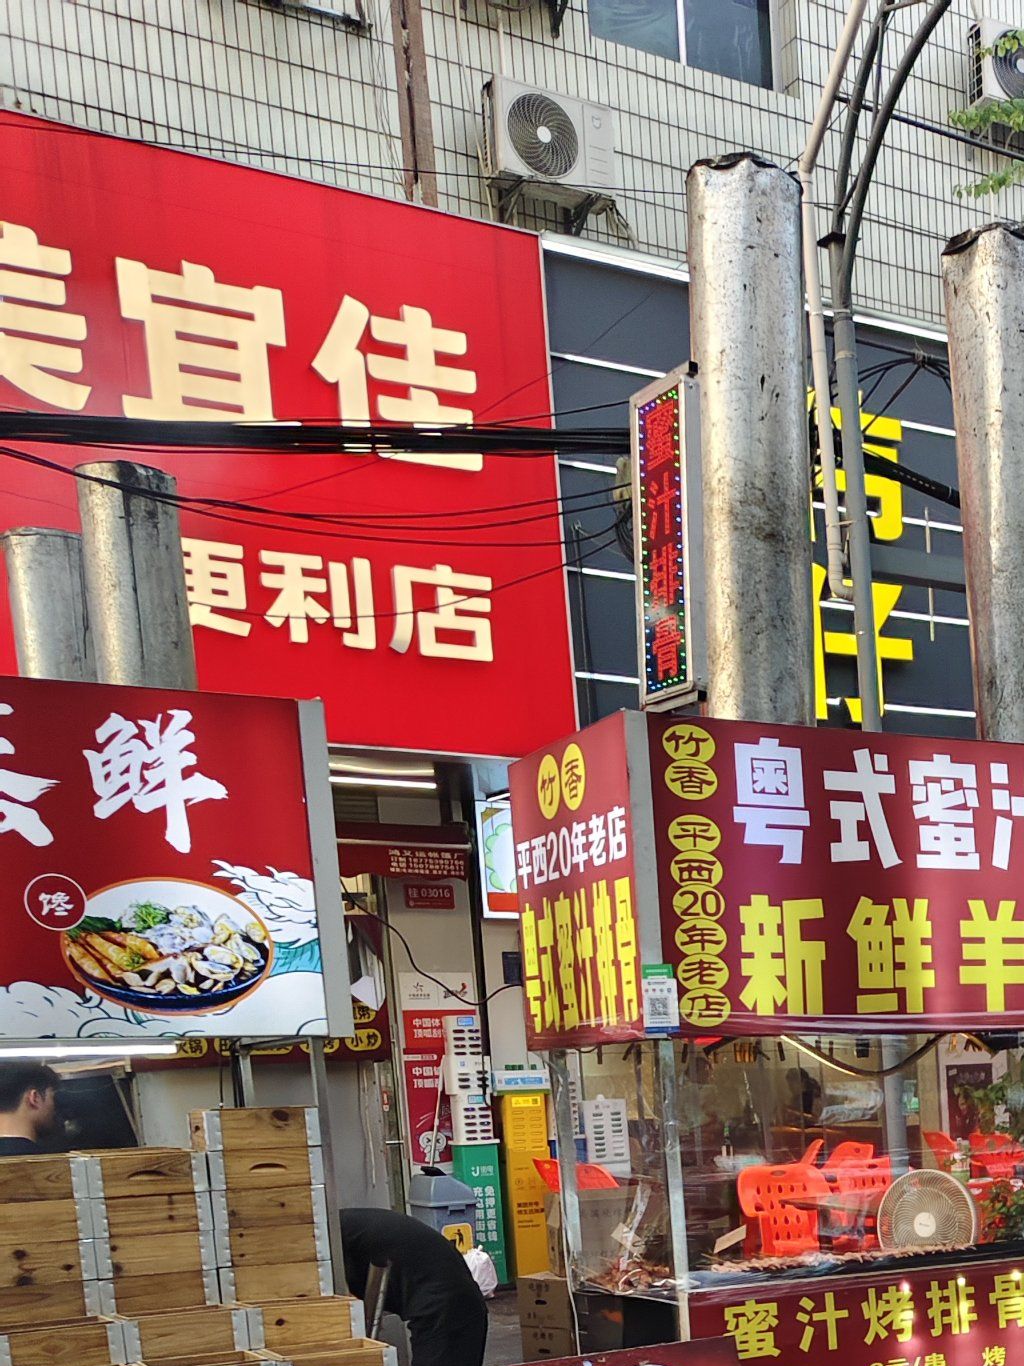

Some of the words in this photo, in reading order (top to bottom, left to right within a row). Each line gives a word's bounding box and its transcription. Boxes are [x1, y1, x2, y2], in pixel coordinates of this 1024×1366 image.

[539, 757, 582, 808] 竹香
[664, 729, 713, 795] 竹香
[516, 805, 627, 890] 平西20年老店
[421, 888, 450, 898] 03016
[674, 820, 730, 1020] 平西20年老店
